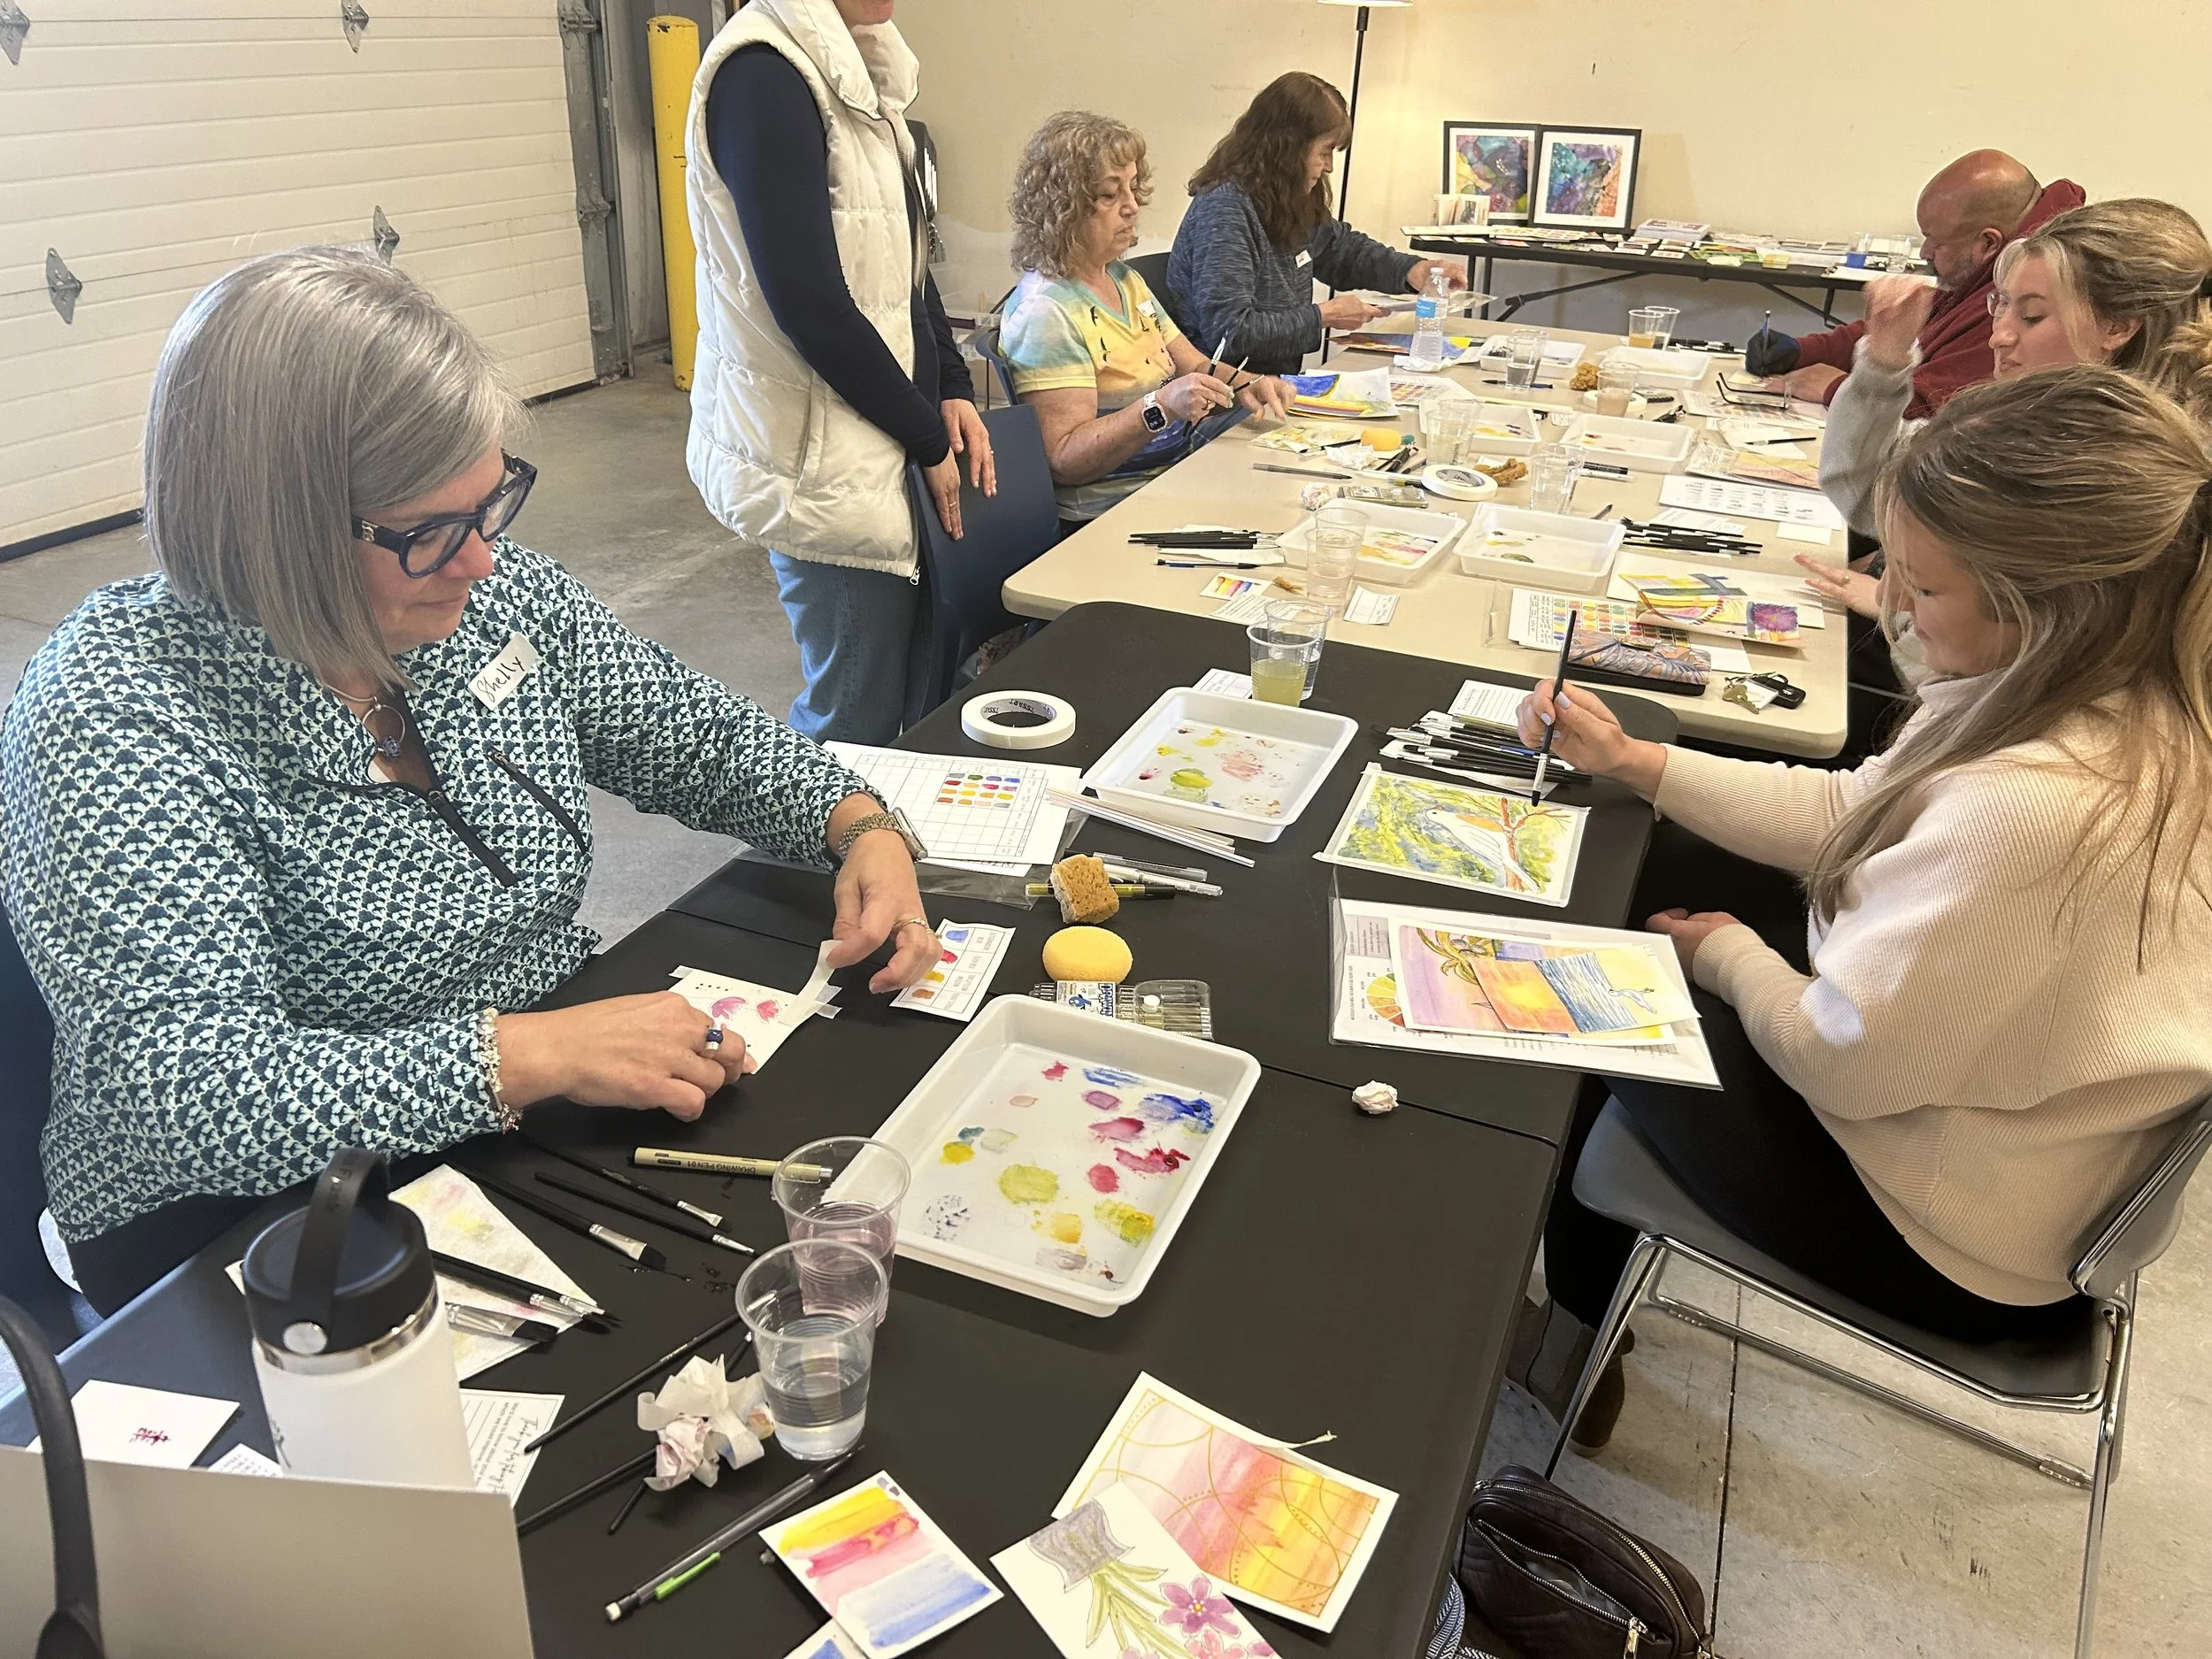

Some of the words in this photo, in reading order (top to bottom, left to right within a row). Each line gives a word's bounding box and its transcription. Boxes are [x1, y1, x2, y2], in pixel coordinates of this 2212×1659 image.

[1009, 698, 1034, 713] TSSART
[697, 1161, 715, 1171] PEN
[716, 1162, 757, 1175] DRAWING
